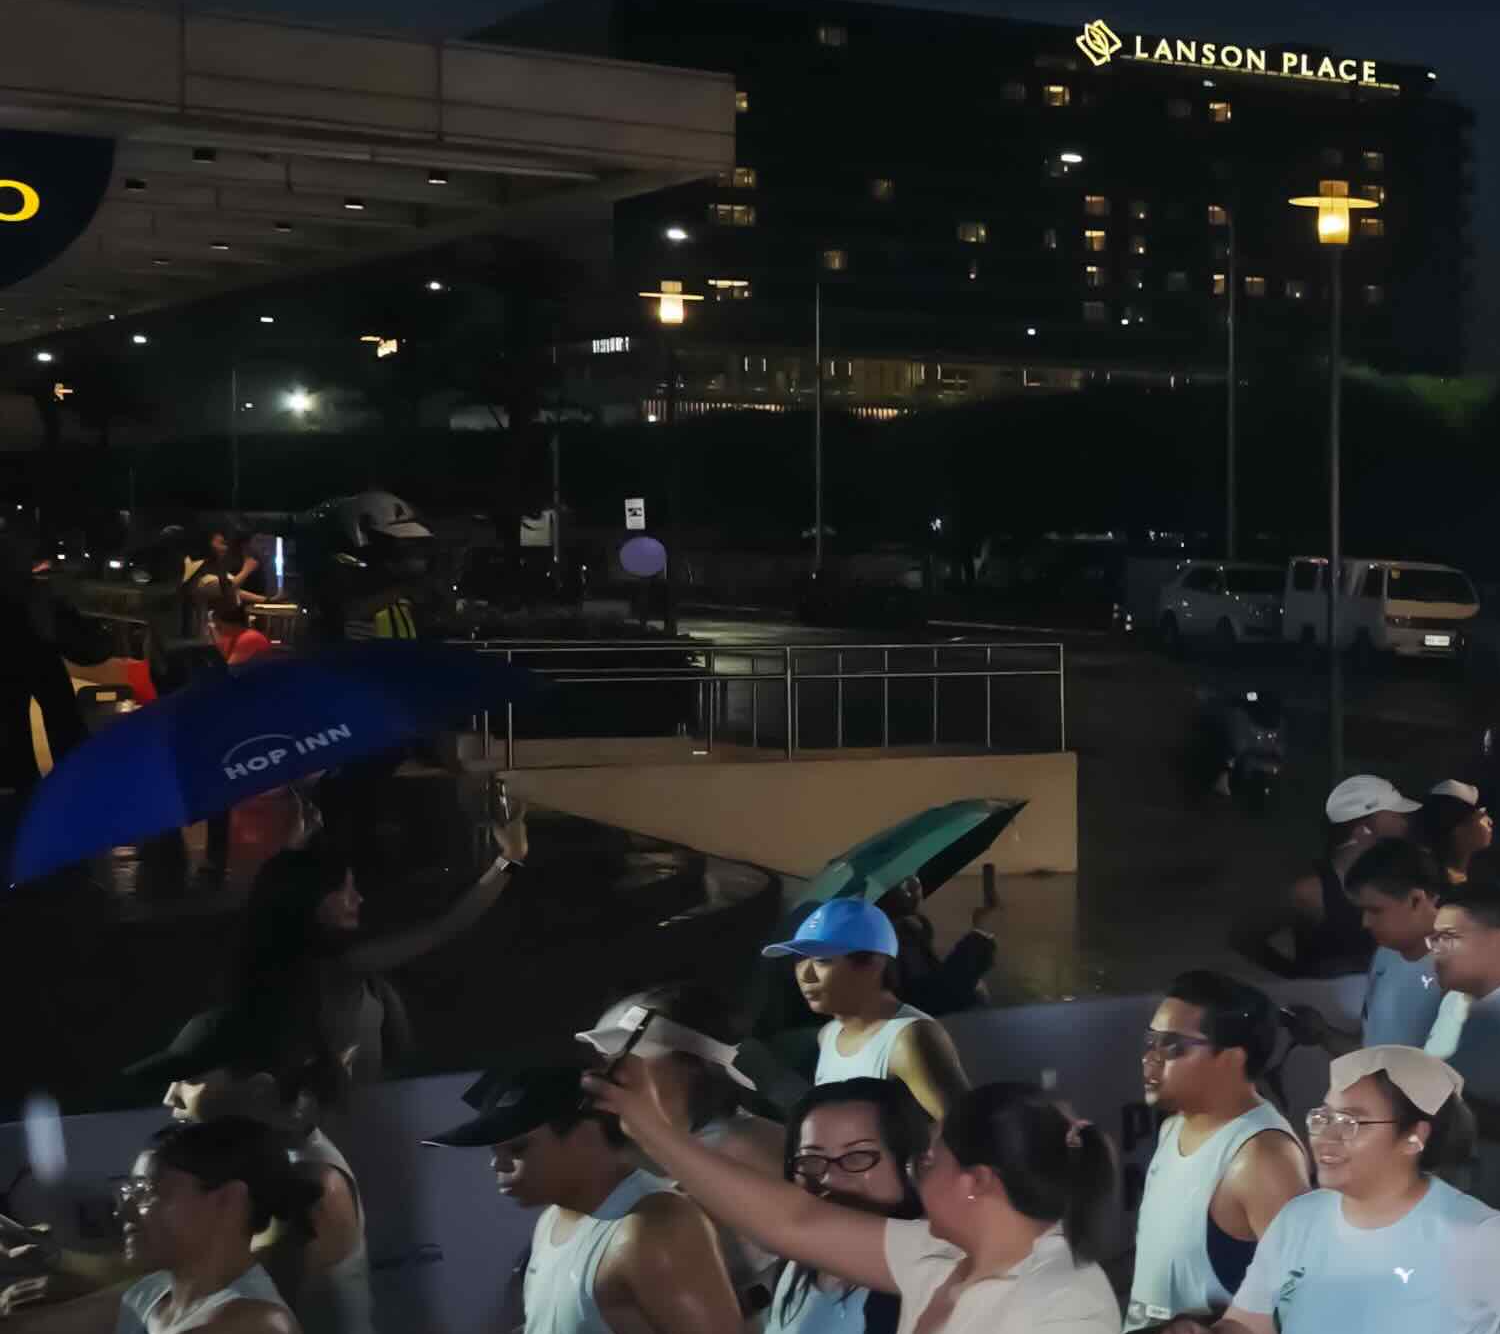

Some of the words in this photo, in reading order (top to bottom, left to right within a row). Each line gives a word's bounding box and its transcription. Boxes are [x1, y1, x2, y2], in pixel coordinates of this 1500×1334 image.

[1135, 35, 1267, 71] LANSON
[1282, 52, 1377, 83] PLACE
[223, 747, 288, 780] HOP
[295, 723, 352, 755] INN
